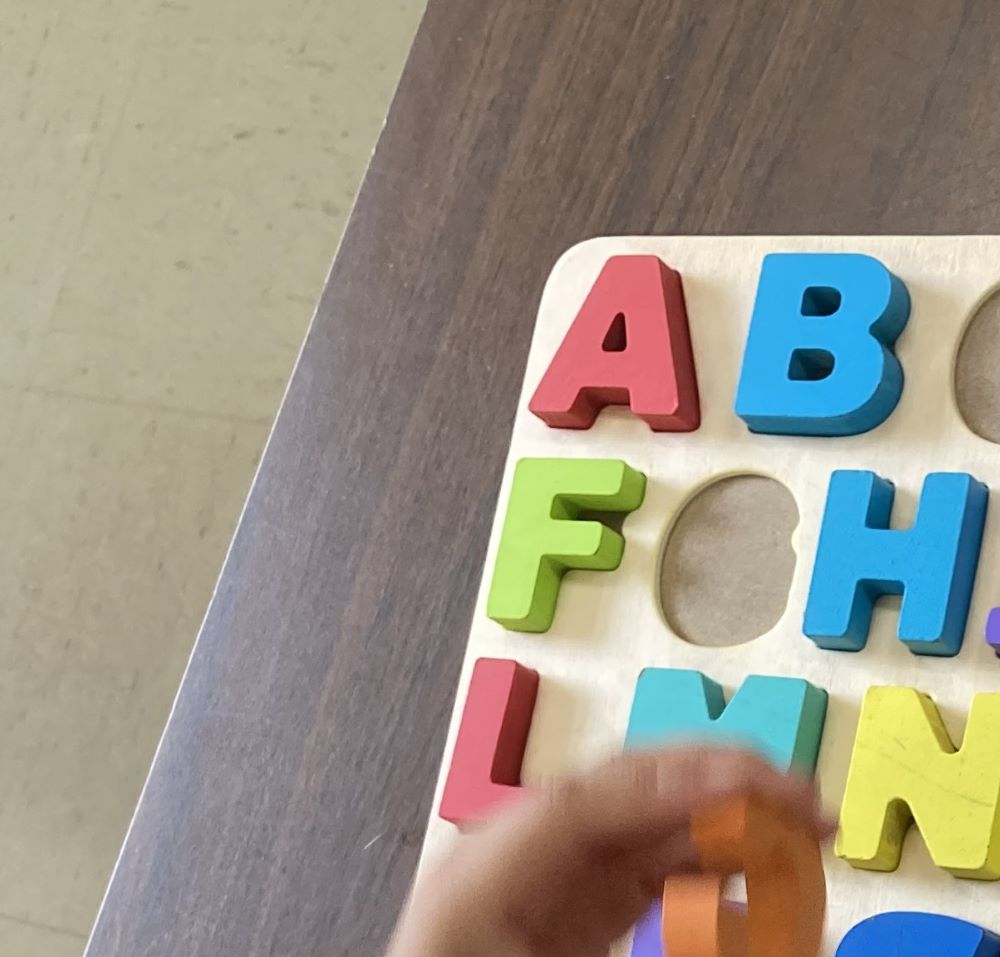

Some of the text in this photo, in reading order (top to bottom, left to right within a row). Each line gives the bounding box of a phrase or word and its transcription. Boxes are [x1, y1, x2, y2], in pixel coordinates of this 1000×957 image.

[529, 255, 700, 432] A
[735, 253, 911, 436] B
[487, 457, 647, 634] F
[803, 469, 988, 657] H
